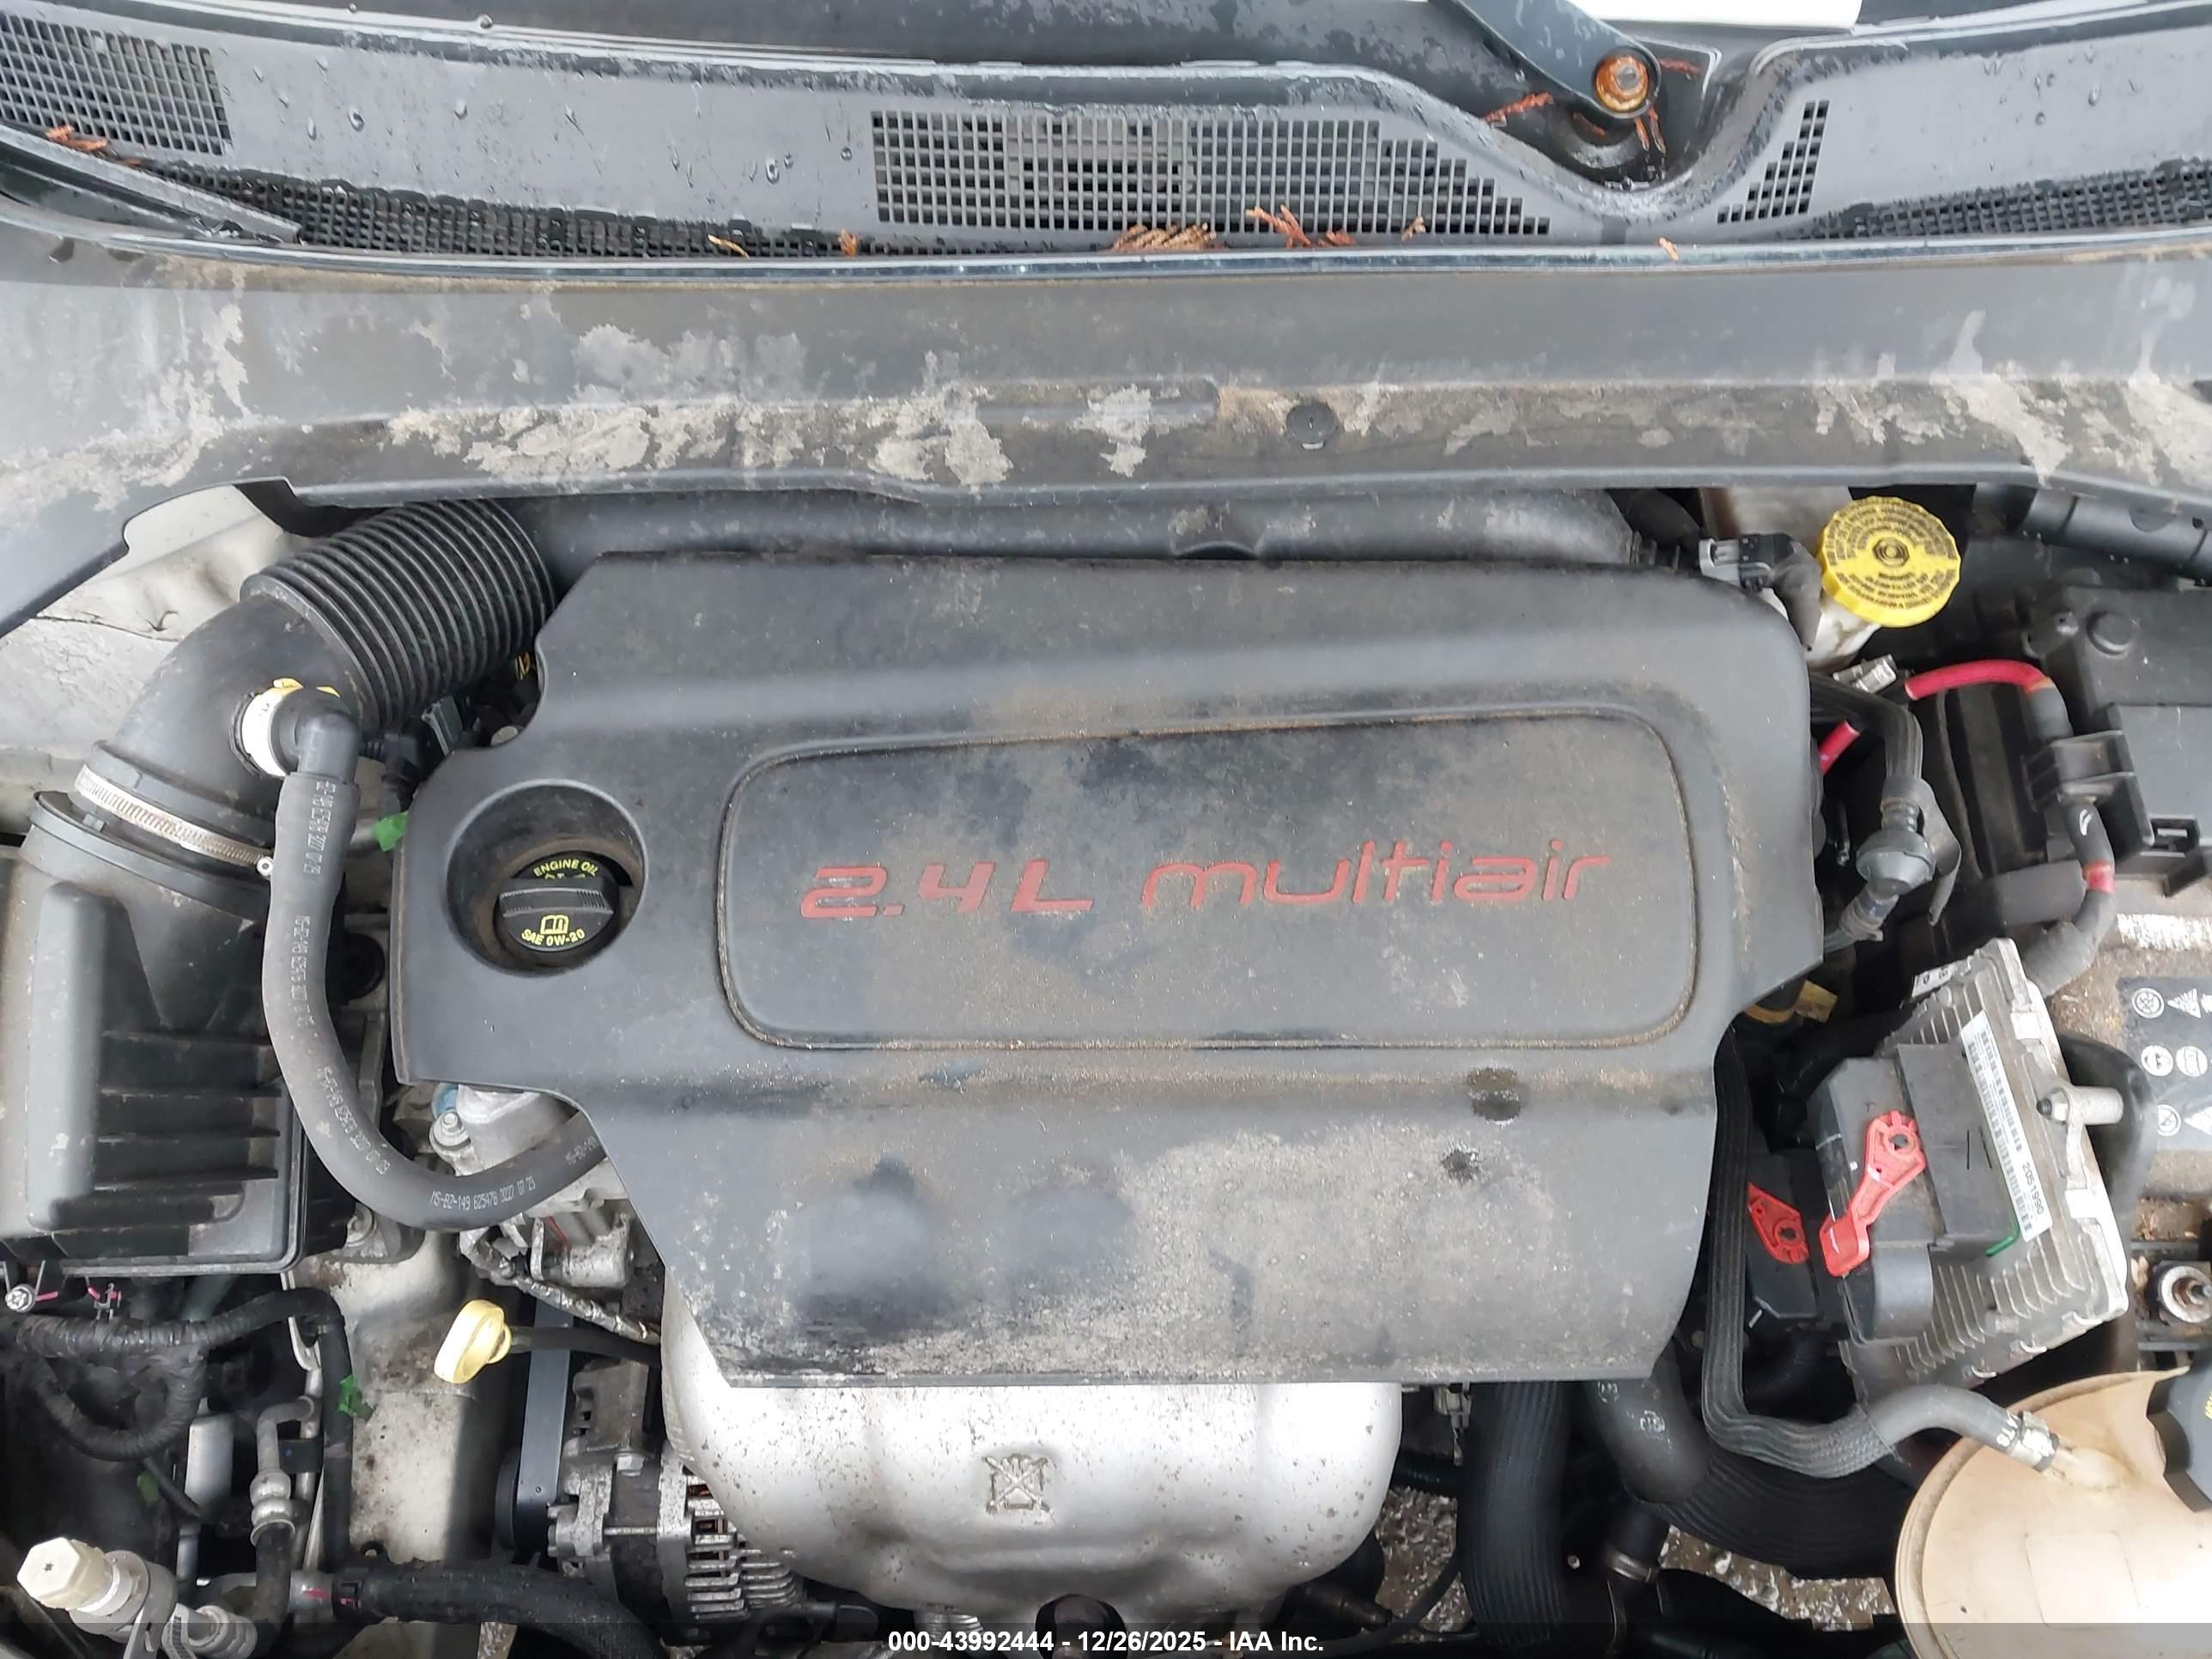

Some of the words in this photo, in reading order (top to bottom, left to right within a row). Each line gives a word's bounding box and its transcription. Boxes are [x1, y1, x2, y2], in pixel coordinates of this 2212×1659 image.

[532, 859, 580, 878] ENGINE
[580, 861, 599, 878] OIL
[800, 859, 1093, 919] 2.4L
[1140, 838, 1611, 908] multiair
[521, 928, 544, 945] SAE
[546, 928, 586, 946] 0W-20
